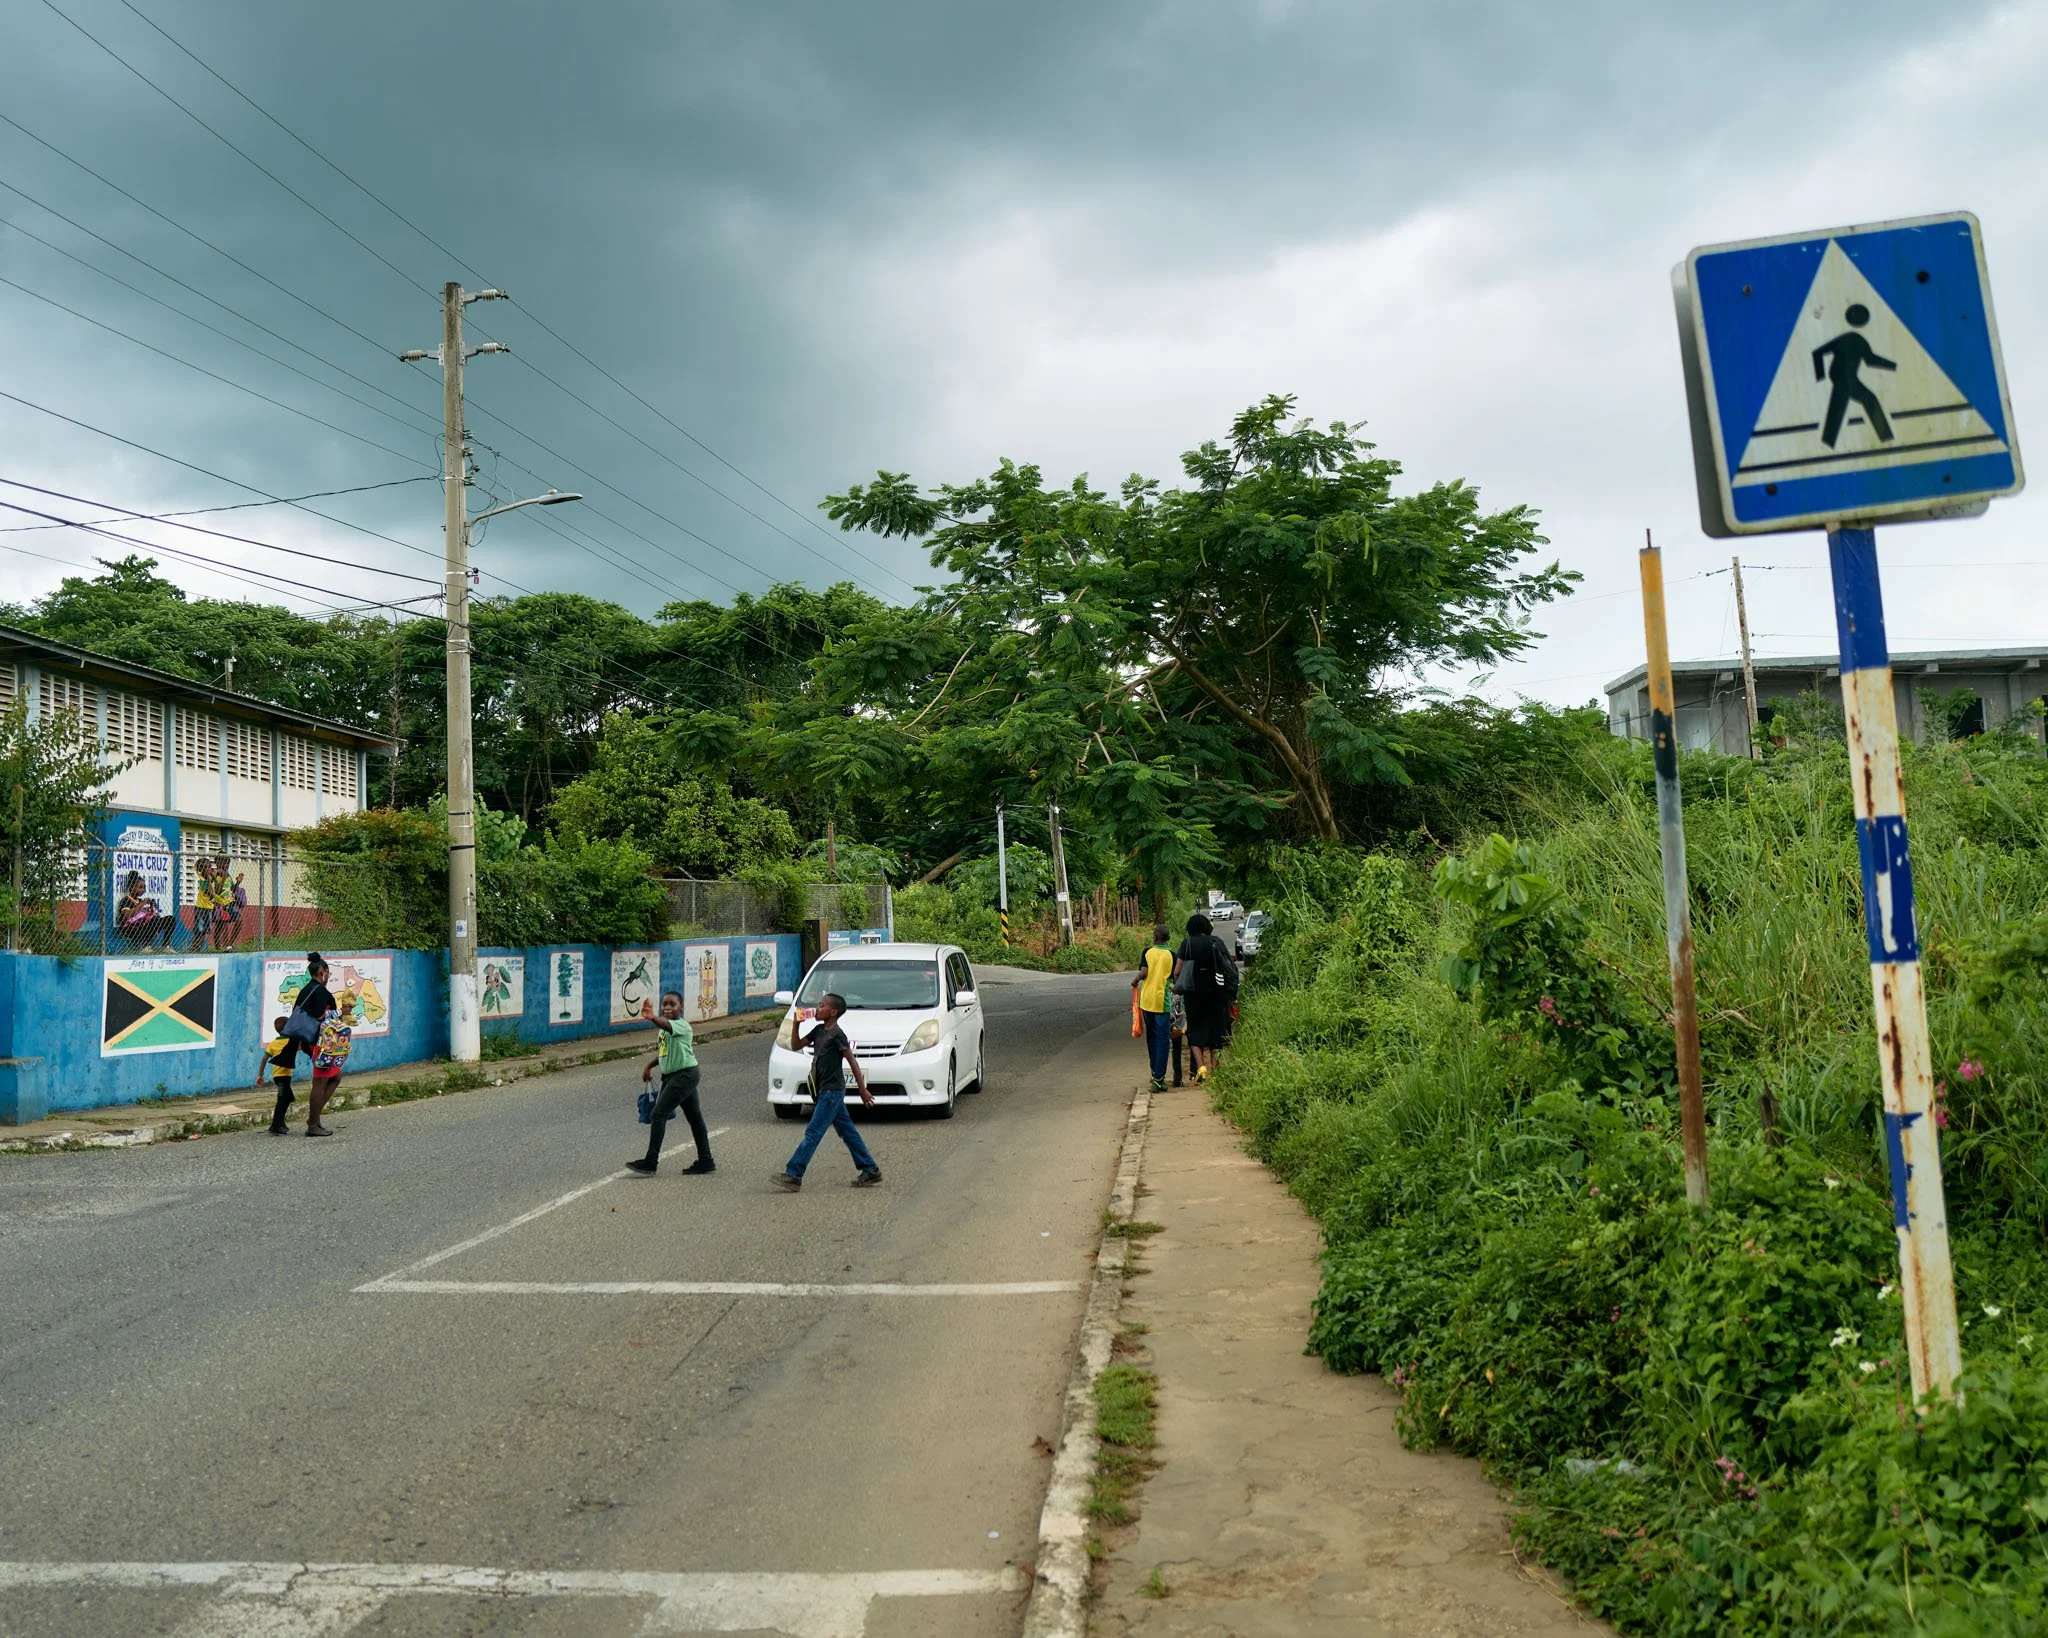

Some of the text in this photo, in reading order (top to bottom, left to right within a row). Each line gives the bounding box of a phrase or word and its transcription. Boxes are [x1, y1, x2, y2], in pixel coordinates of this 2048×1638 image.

[137, 830, 144, 840] OF
[116, 853, 168, 872] SANTA CRUZ
[148, 875, 168, 895] INFANT
